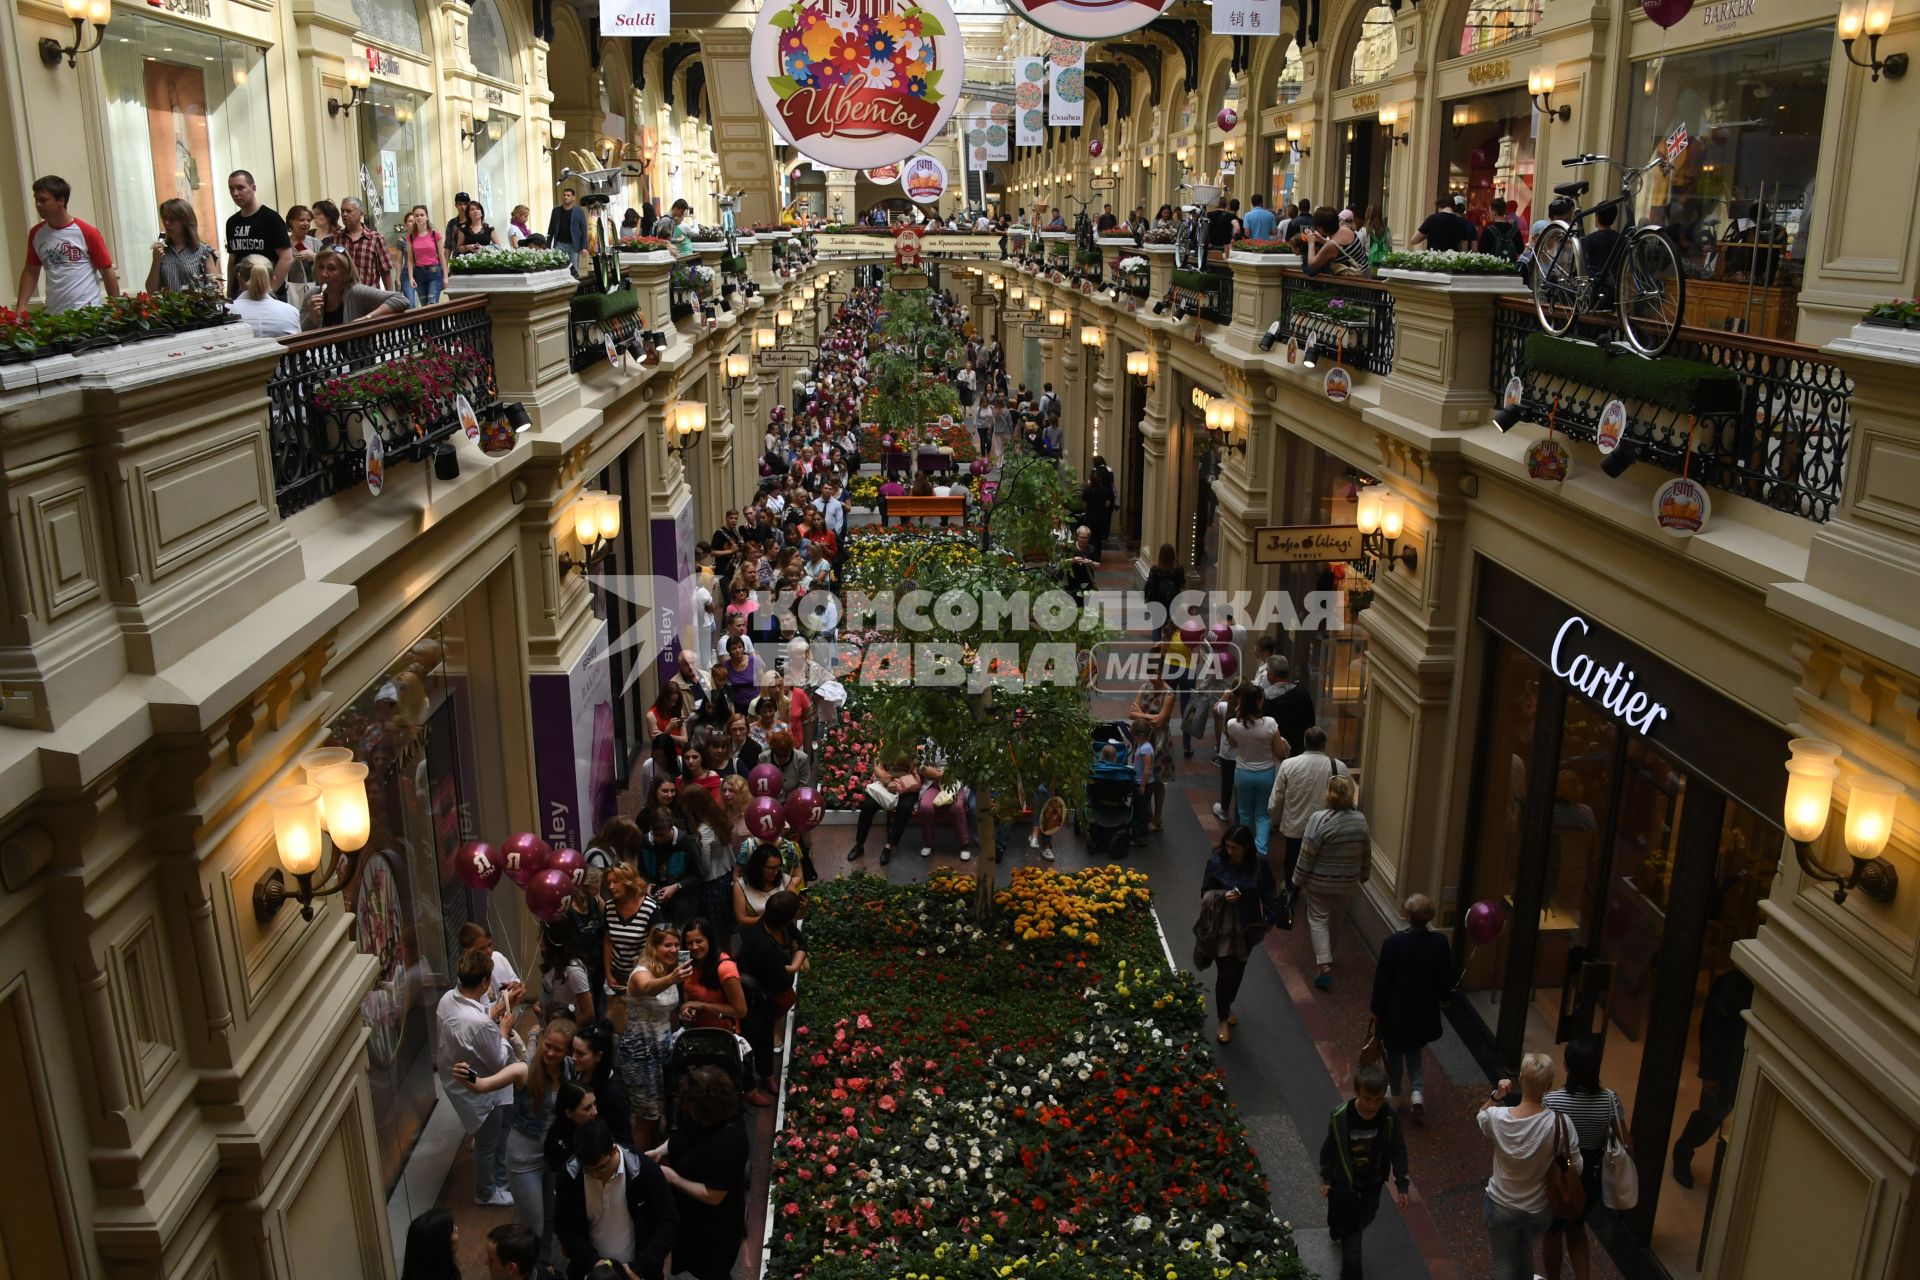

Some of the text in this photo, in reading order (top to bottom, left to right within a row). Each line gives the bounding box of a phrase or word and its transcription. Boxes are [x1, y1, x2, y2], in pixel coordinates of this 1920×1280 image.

[615, 13, 655, 26] Saldi
[1230, 11, 1261, 28] 销售
[1703, 0, 1754, 25] BARKER
[783, 73, 924, 136] Цветы
[233, 225, 251, 237] SAN
[230, 238, 265, 251] ANCISCO
[660, 606, 674, 664] sisley
[1551, 616, 1667, 736] Cartier
[549, 800, 570, 851] sley
